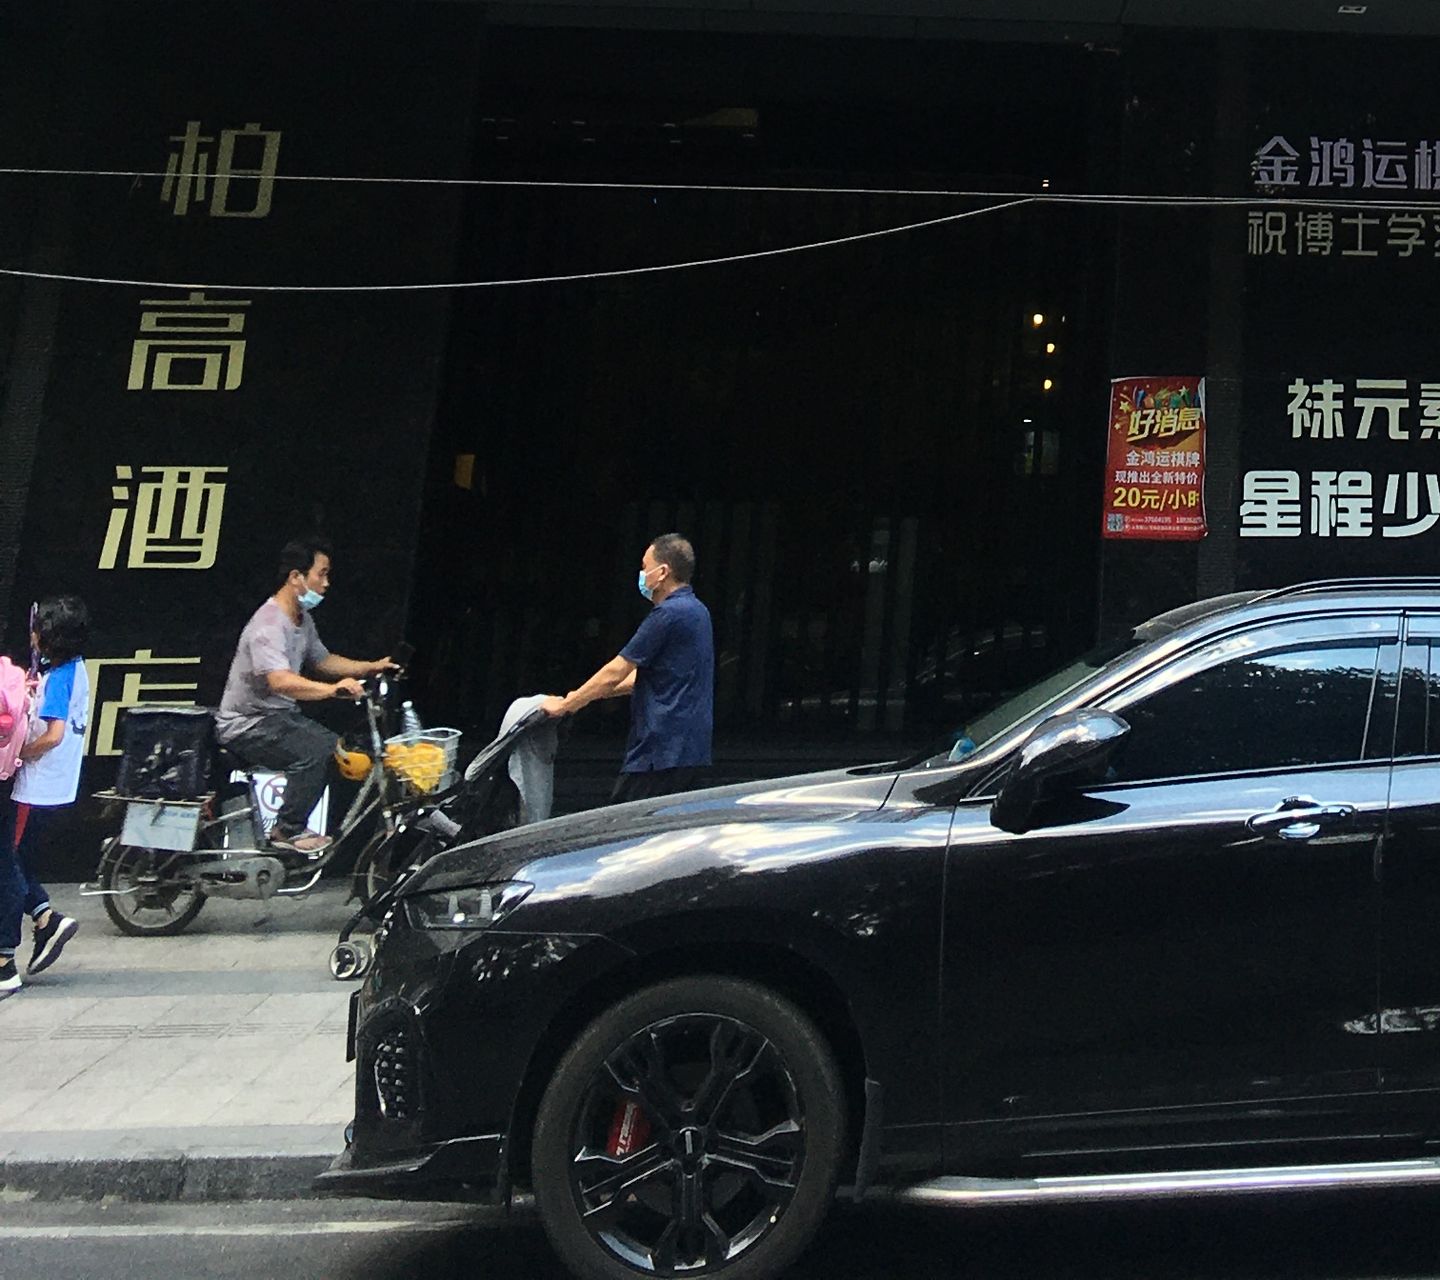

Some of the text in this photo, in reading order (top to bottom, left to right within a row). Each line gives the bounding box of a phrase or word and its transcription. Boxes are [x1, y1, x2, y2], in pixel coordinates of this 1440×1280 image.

[1126, 407, 1201, 441] 好消息
[1125, 450, 1200, 469] 金鸿运棋牌
[1115, 470, 1199, 485] 现推出全新特价
